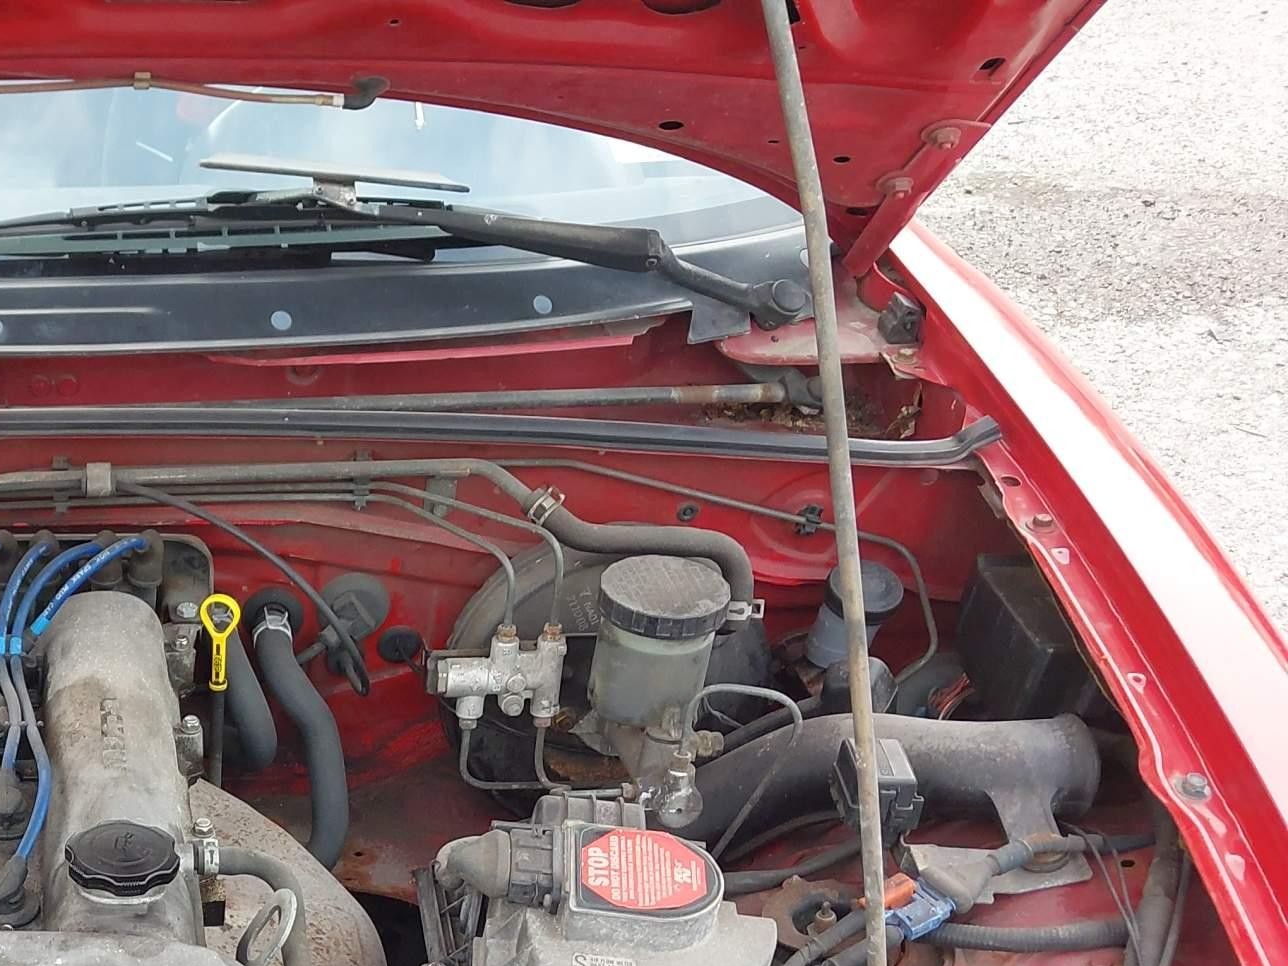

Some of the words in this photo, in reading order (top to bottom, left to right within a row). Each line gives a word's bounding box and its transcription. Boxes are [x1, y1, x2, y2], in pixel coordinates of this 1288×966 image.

[72, 564, 92, 583] SPARK
[609, 836, 620, 869] DISCARD
[587, 847, 609, 887] STOP
[610, 870, 620, 888] NOT
[610, 889, 621, 900] DO
